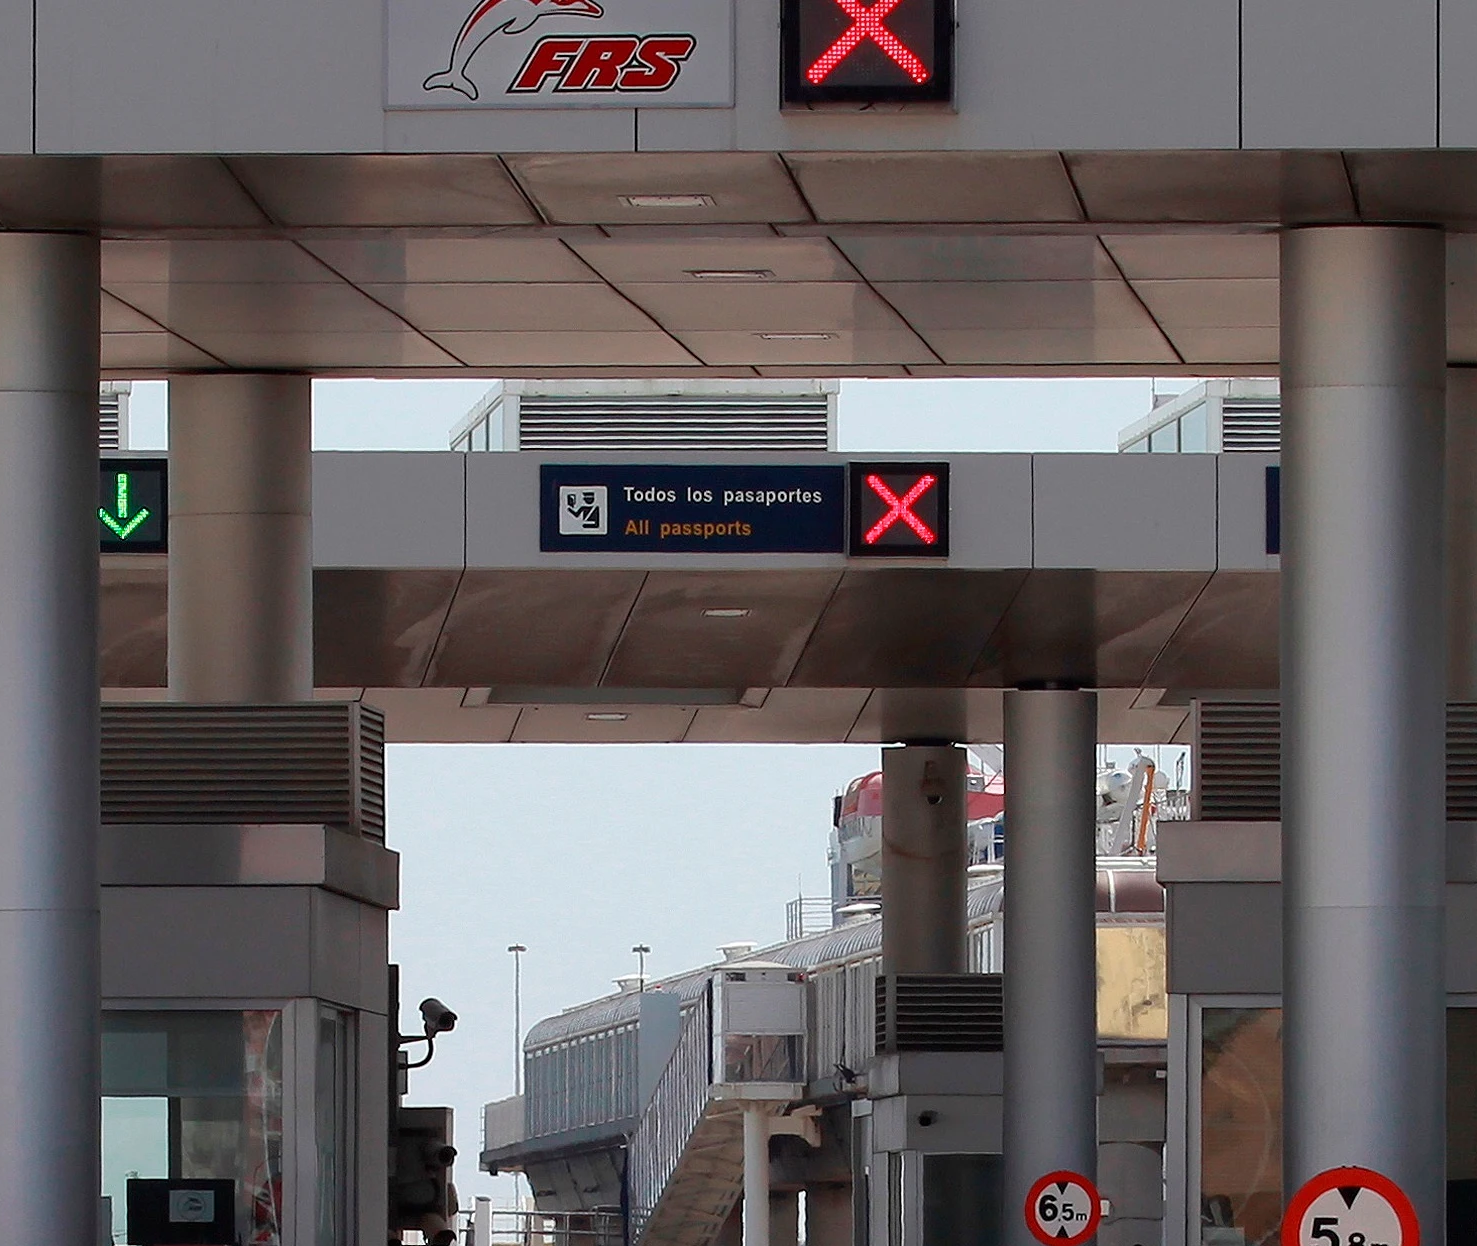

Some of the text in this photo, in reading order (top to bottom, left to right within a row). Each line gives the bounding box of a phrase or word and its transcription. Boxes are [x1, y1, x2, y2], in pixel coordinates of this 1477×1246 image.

[507, 34, 696, 93] FRS
[623, 486, 822, 506] Todos los pasaportes
[625, 520, 751, 539] All passports
